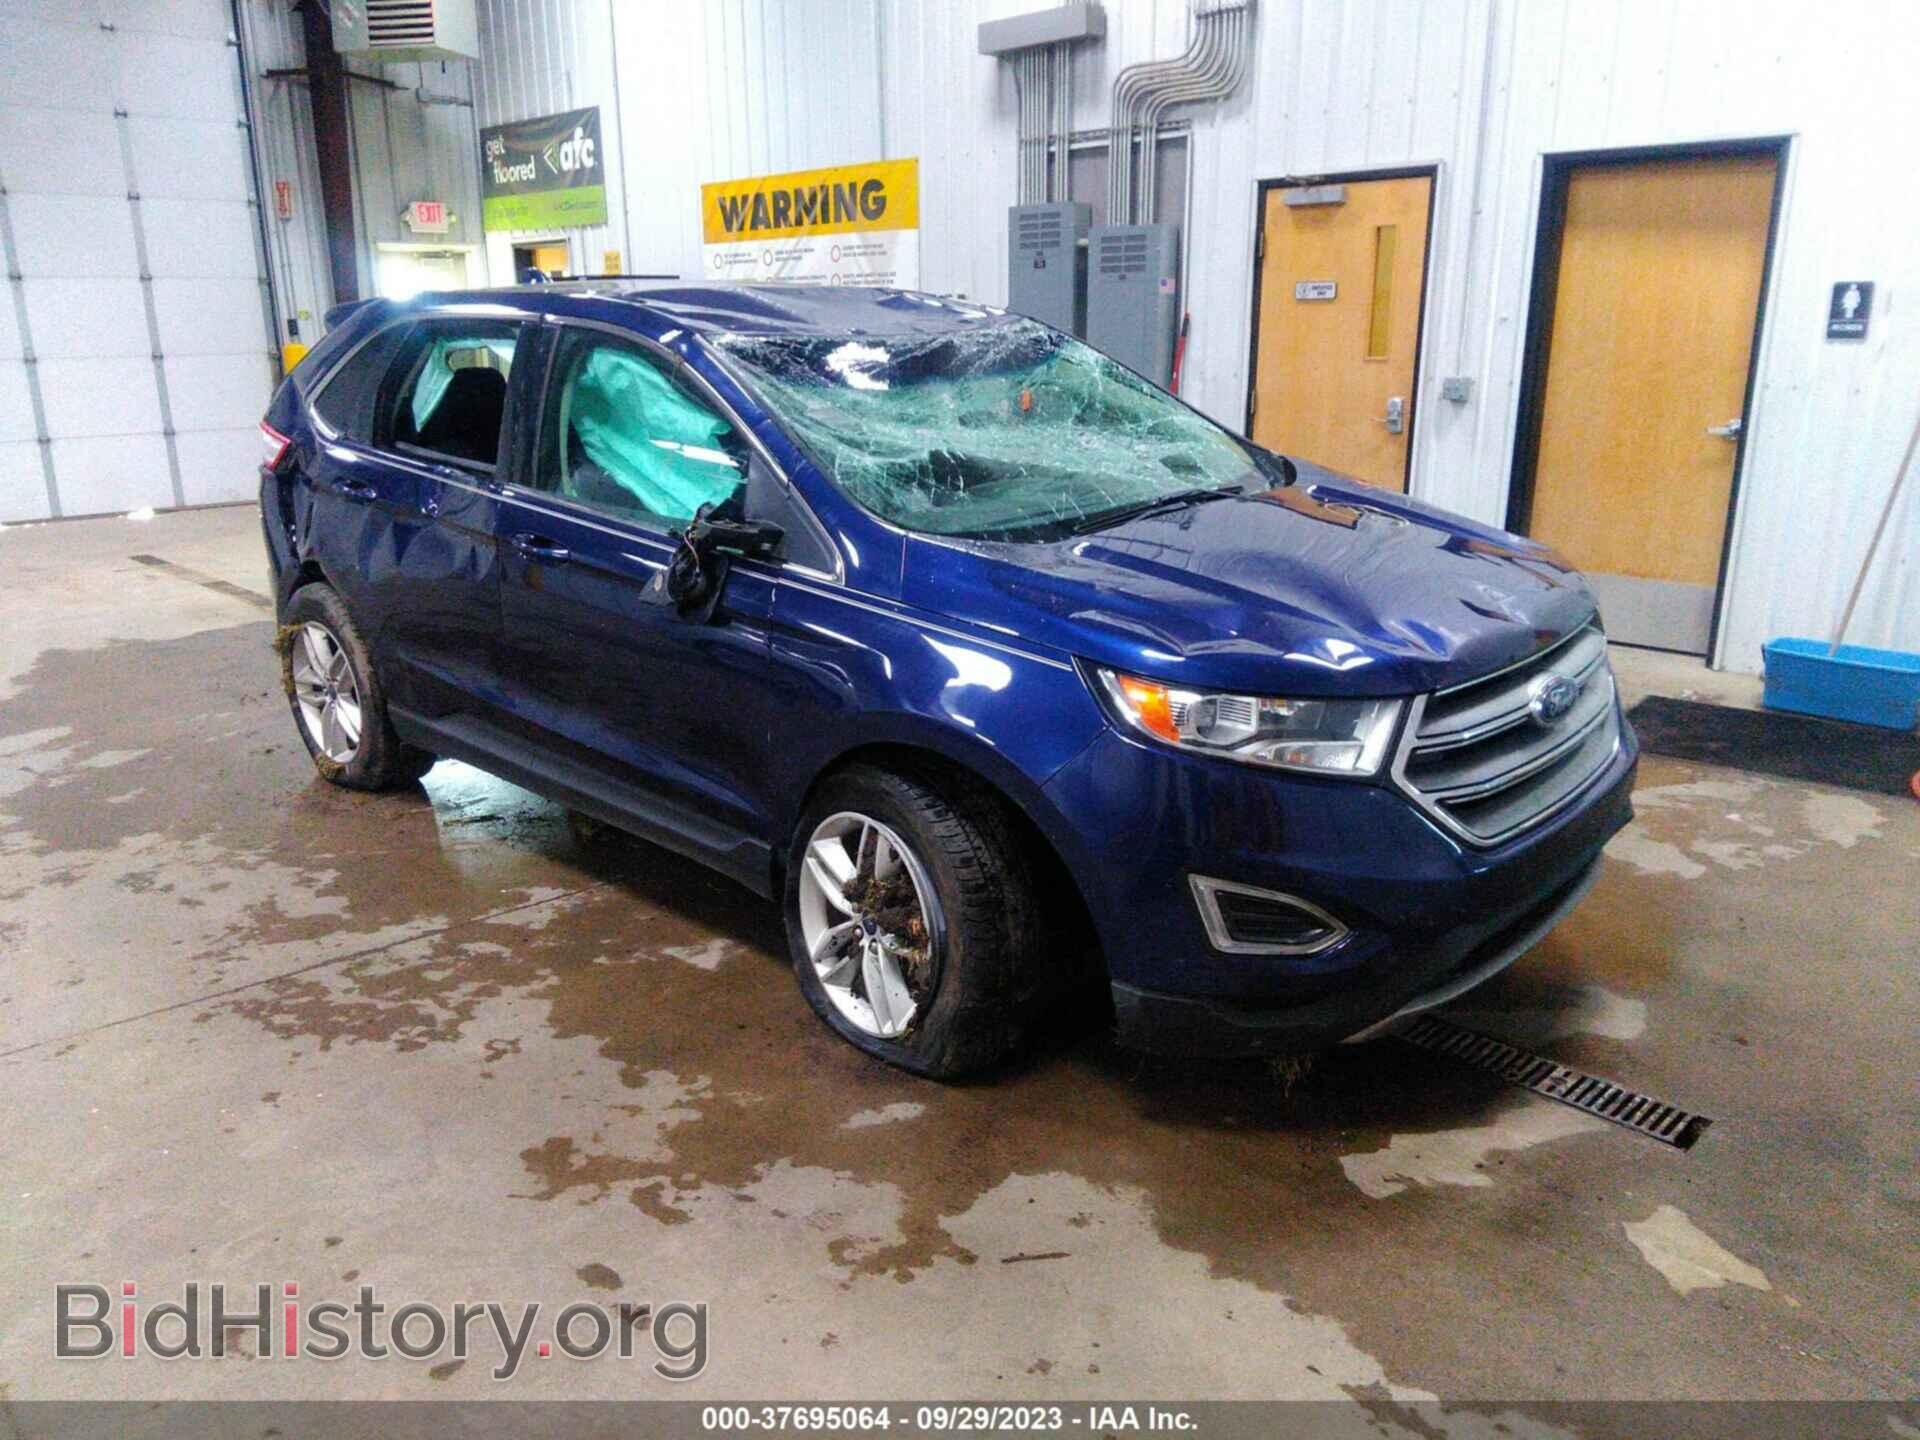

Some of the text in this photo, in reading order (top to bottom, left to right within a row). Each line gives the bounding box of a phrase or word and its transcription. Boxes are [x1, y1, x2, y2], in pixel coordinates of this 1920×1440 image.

[486, 135, 505, 162] get
[560, 127, 595, 171] afc
[494, 155, 536, 184] floored
[416, 204, 443, 224] EXIT
[718, 179, 887, 232] WARNING
